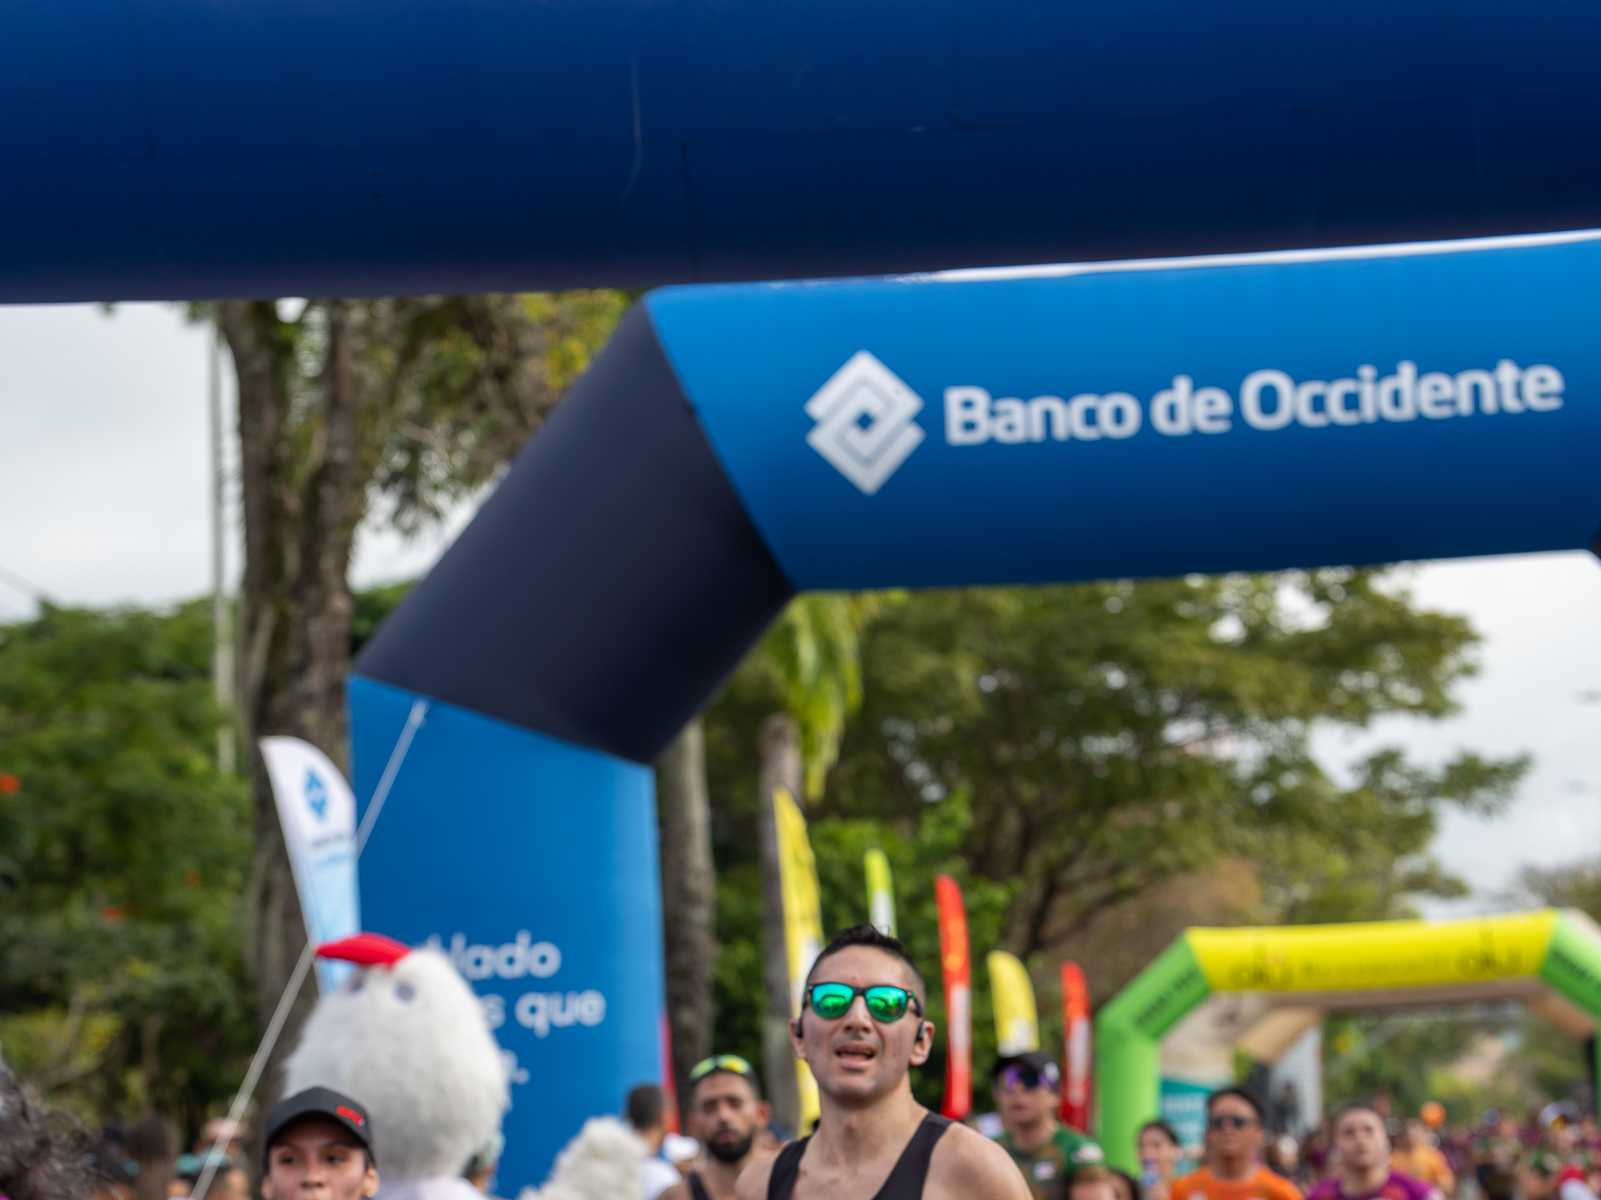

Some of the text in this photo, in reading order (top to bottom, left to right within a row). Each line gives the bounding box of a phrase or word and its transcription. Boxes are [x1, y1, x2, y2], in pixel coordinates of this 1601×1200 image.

[943, 360, 1564, 446] Banco de Occidente
[515, 990, 607, 1039] que
